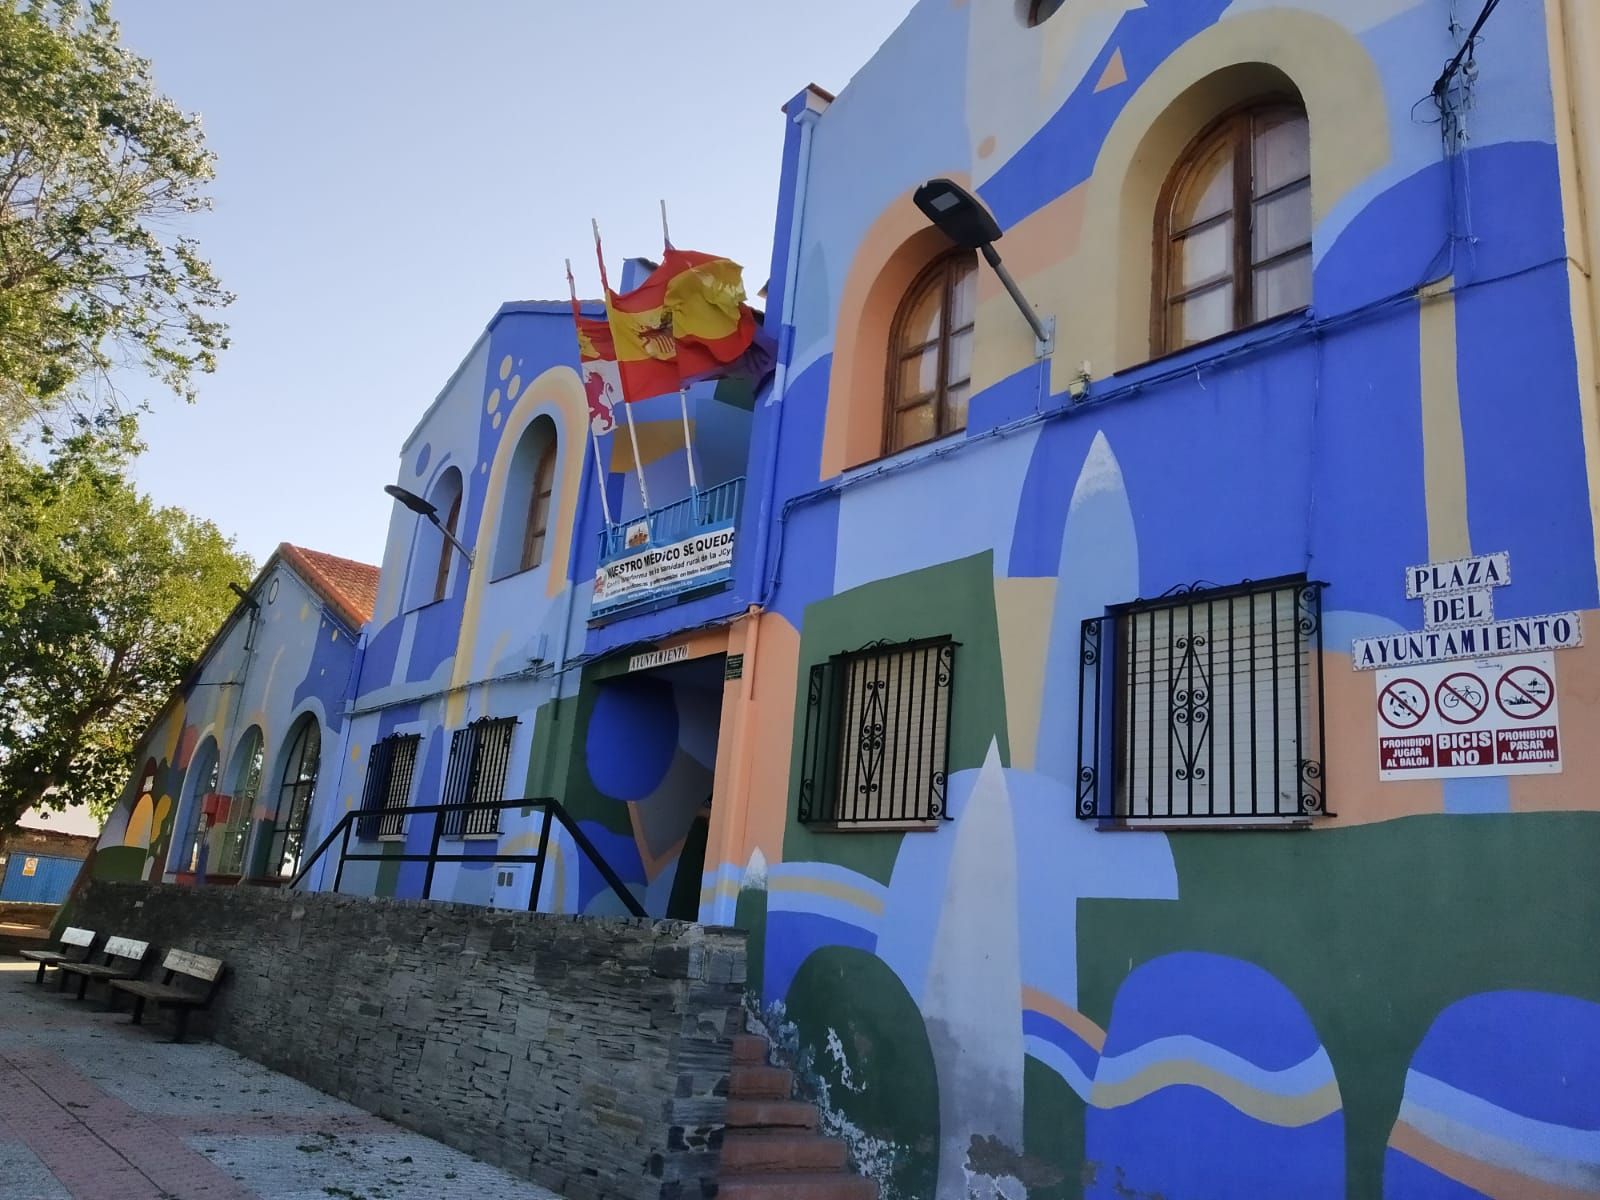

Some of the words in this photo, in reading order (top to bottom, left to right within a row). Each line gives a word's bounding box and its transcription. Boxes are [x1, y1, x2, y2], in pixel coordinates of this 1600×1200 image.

[683, 541, 695, 556] SE
[695, 532, 735, 551] QUEDA
[1415, 559, 1500, 592] PLAZA
[1433, 595, 1482, 623] DEL
[1361, 618, 1570, 664] AYUNTAMIENTO
[1382, 737, 1431, 748] PROHIBIDO
[1439, 731, 1492, 750] BICIS
[1499, 729, 1554, 742] PROHIBIDO
[1392, 748, 1423, 758] JUGAR
[1510, 740, 1544, 751] PASAR
[1386, 759, 1397, 768] AL
[1451, 749, 1480, 766] NO
[1501, 751, 1514, 762] AL
